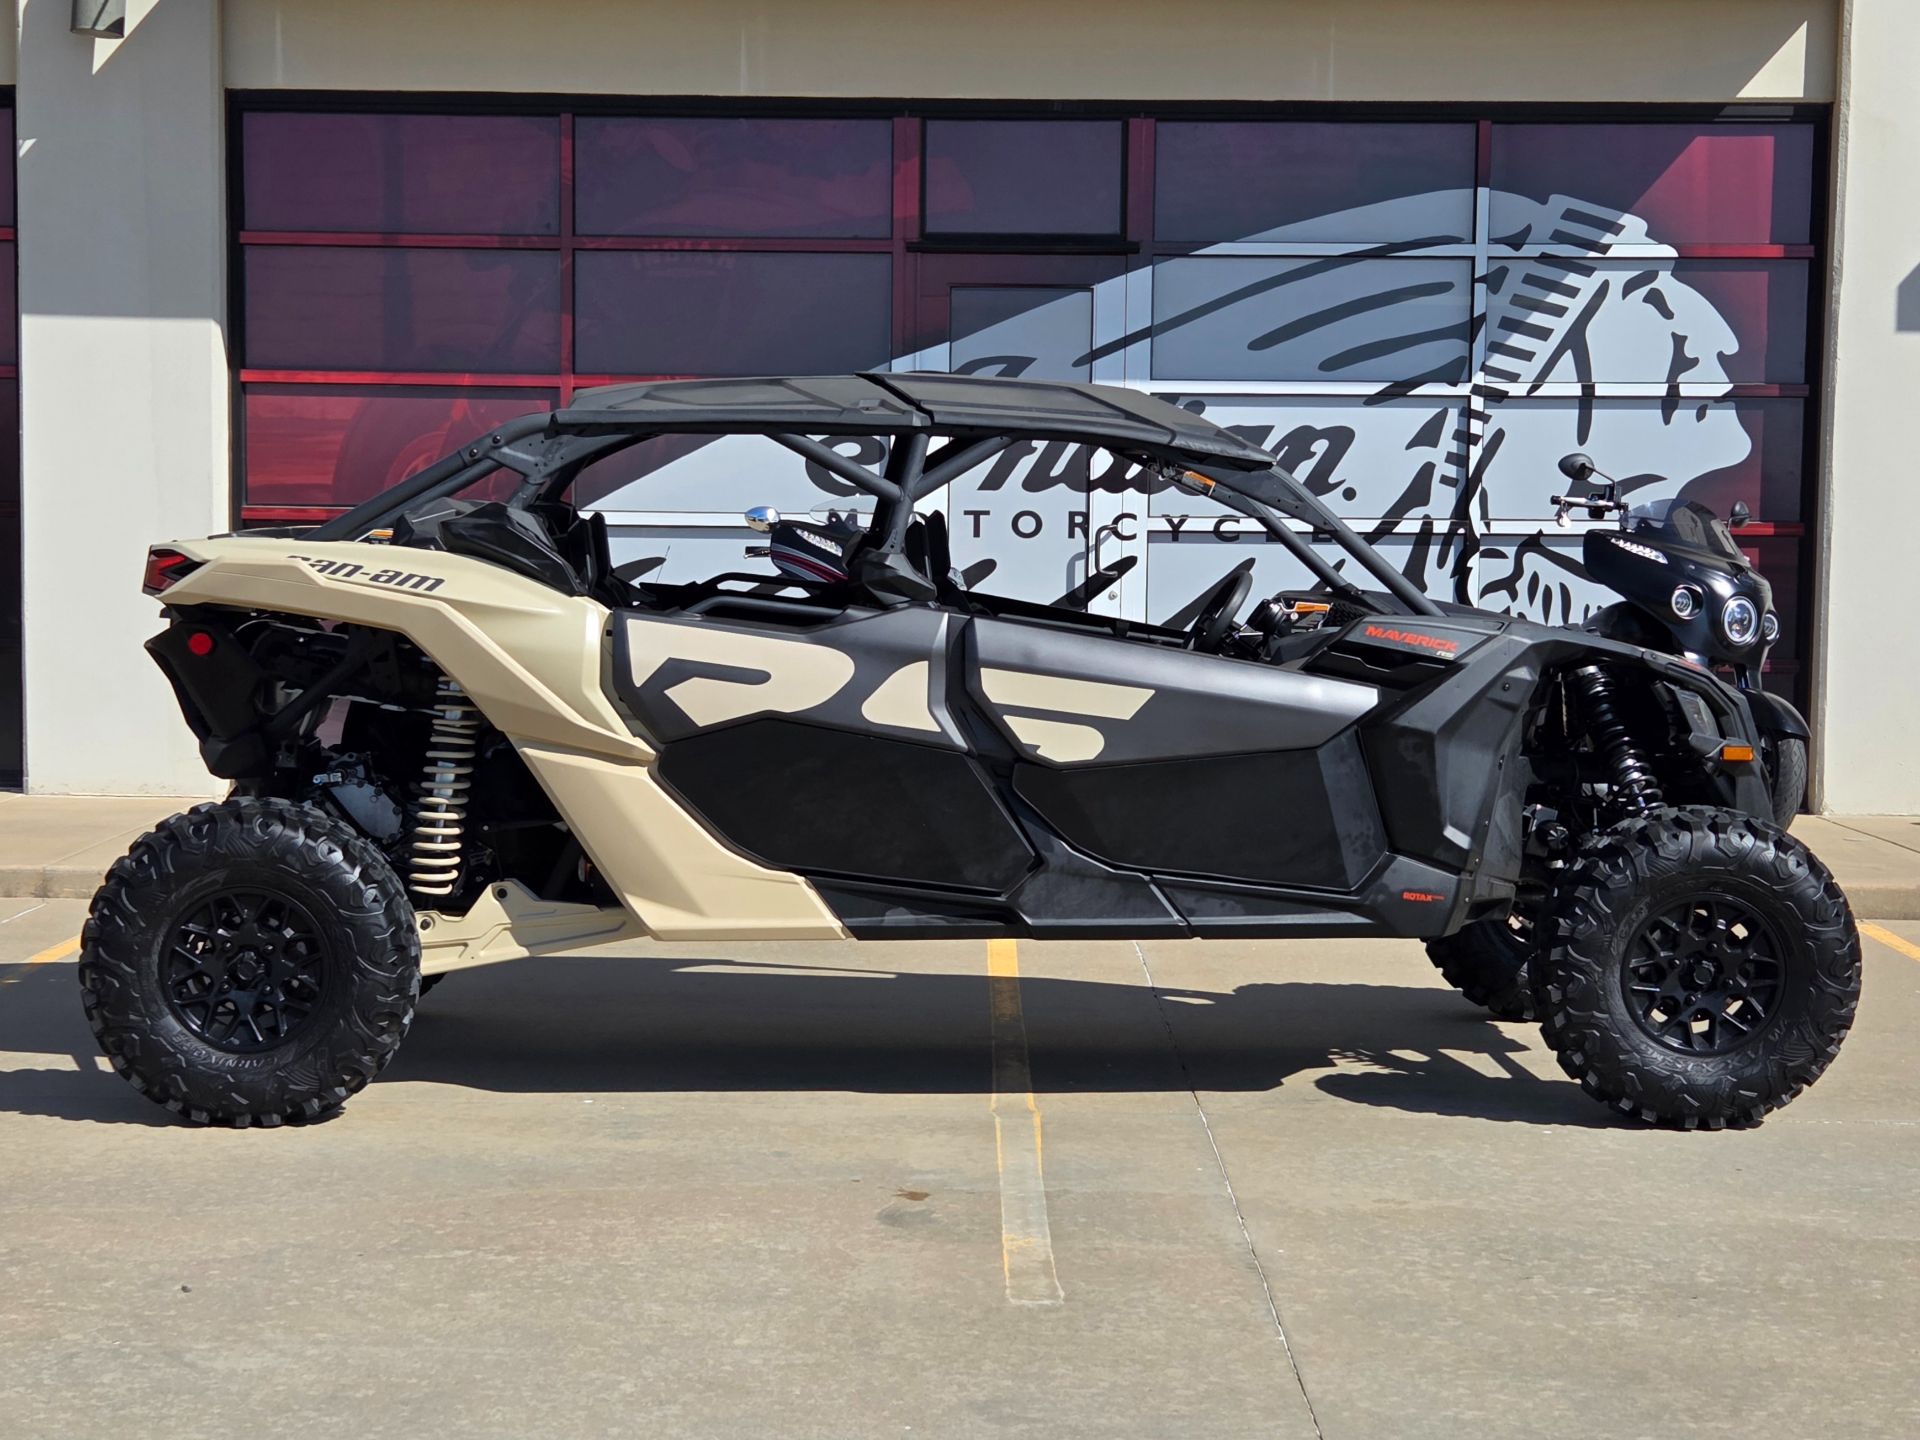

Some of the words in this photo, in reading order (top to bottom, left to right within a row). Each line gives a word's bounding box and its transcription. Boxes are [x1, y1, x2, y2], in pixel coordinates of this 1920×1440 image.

[287, 555, 445, 592] an-am
[1365, 625, 1457, 652] MAVERICK
[1402, 891, 1433, 902] ROTAX
